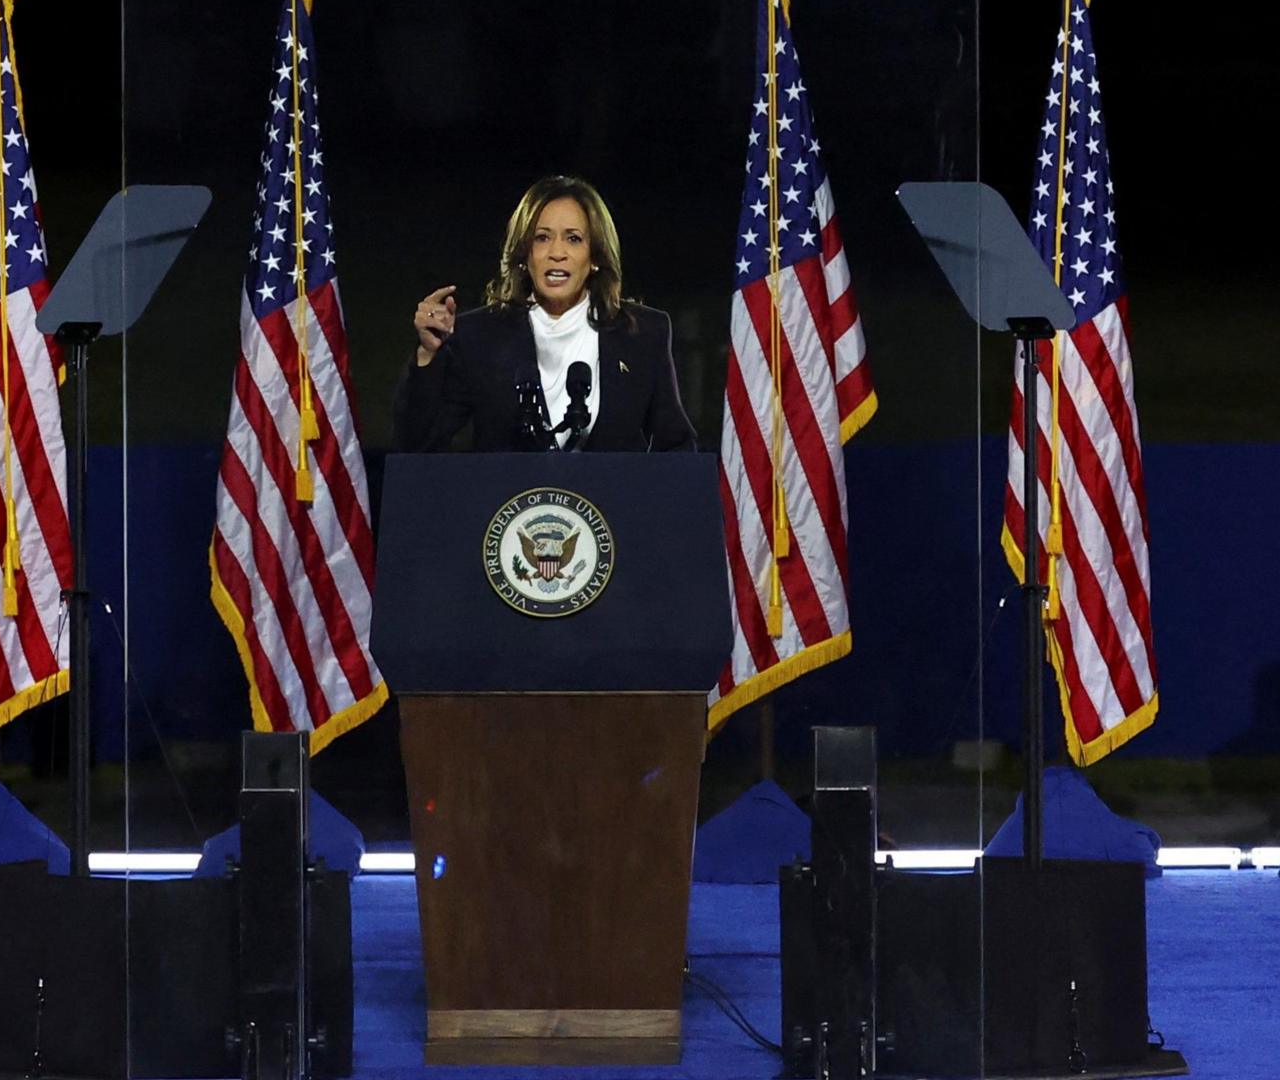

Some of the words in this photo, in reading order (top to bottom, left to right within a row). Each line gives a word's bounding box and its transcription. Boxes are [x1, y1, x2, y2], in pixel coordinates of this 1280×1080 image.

[527, 493, 543, 506] OF
[548, 492, 571, 506] THE
[486, 499, 523, 576] PRESIDENT
[575, 500, 611, 554] UNITED
[497, 580, 526, 609] VICE
[570, 561, 610, 608] STATES
